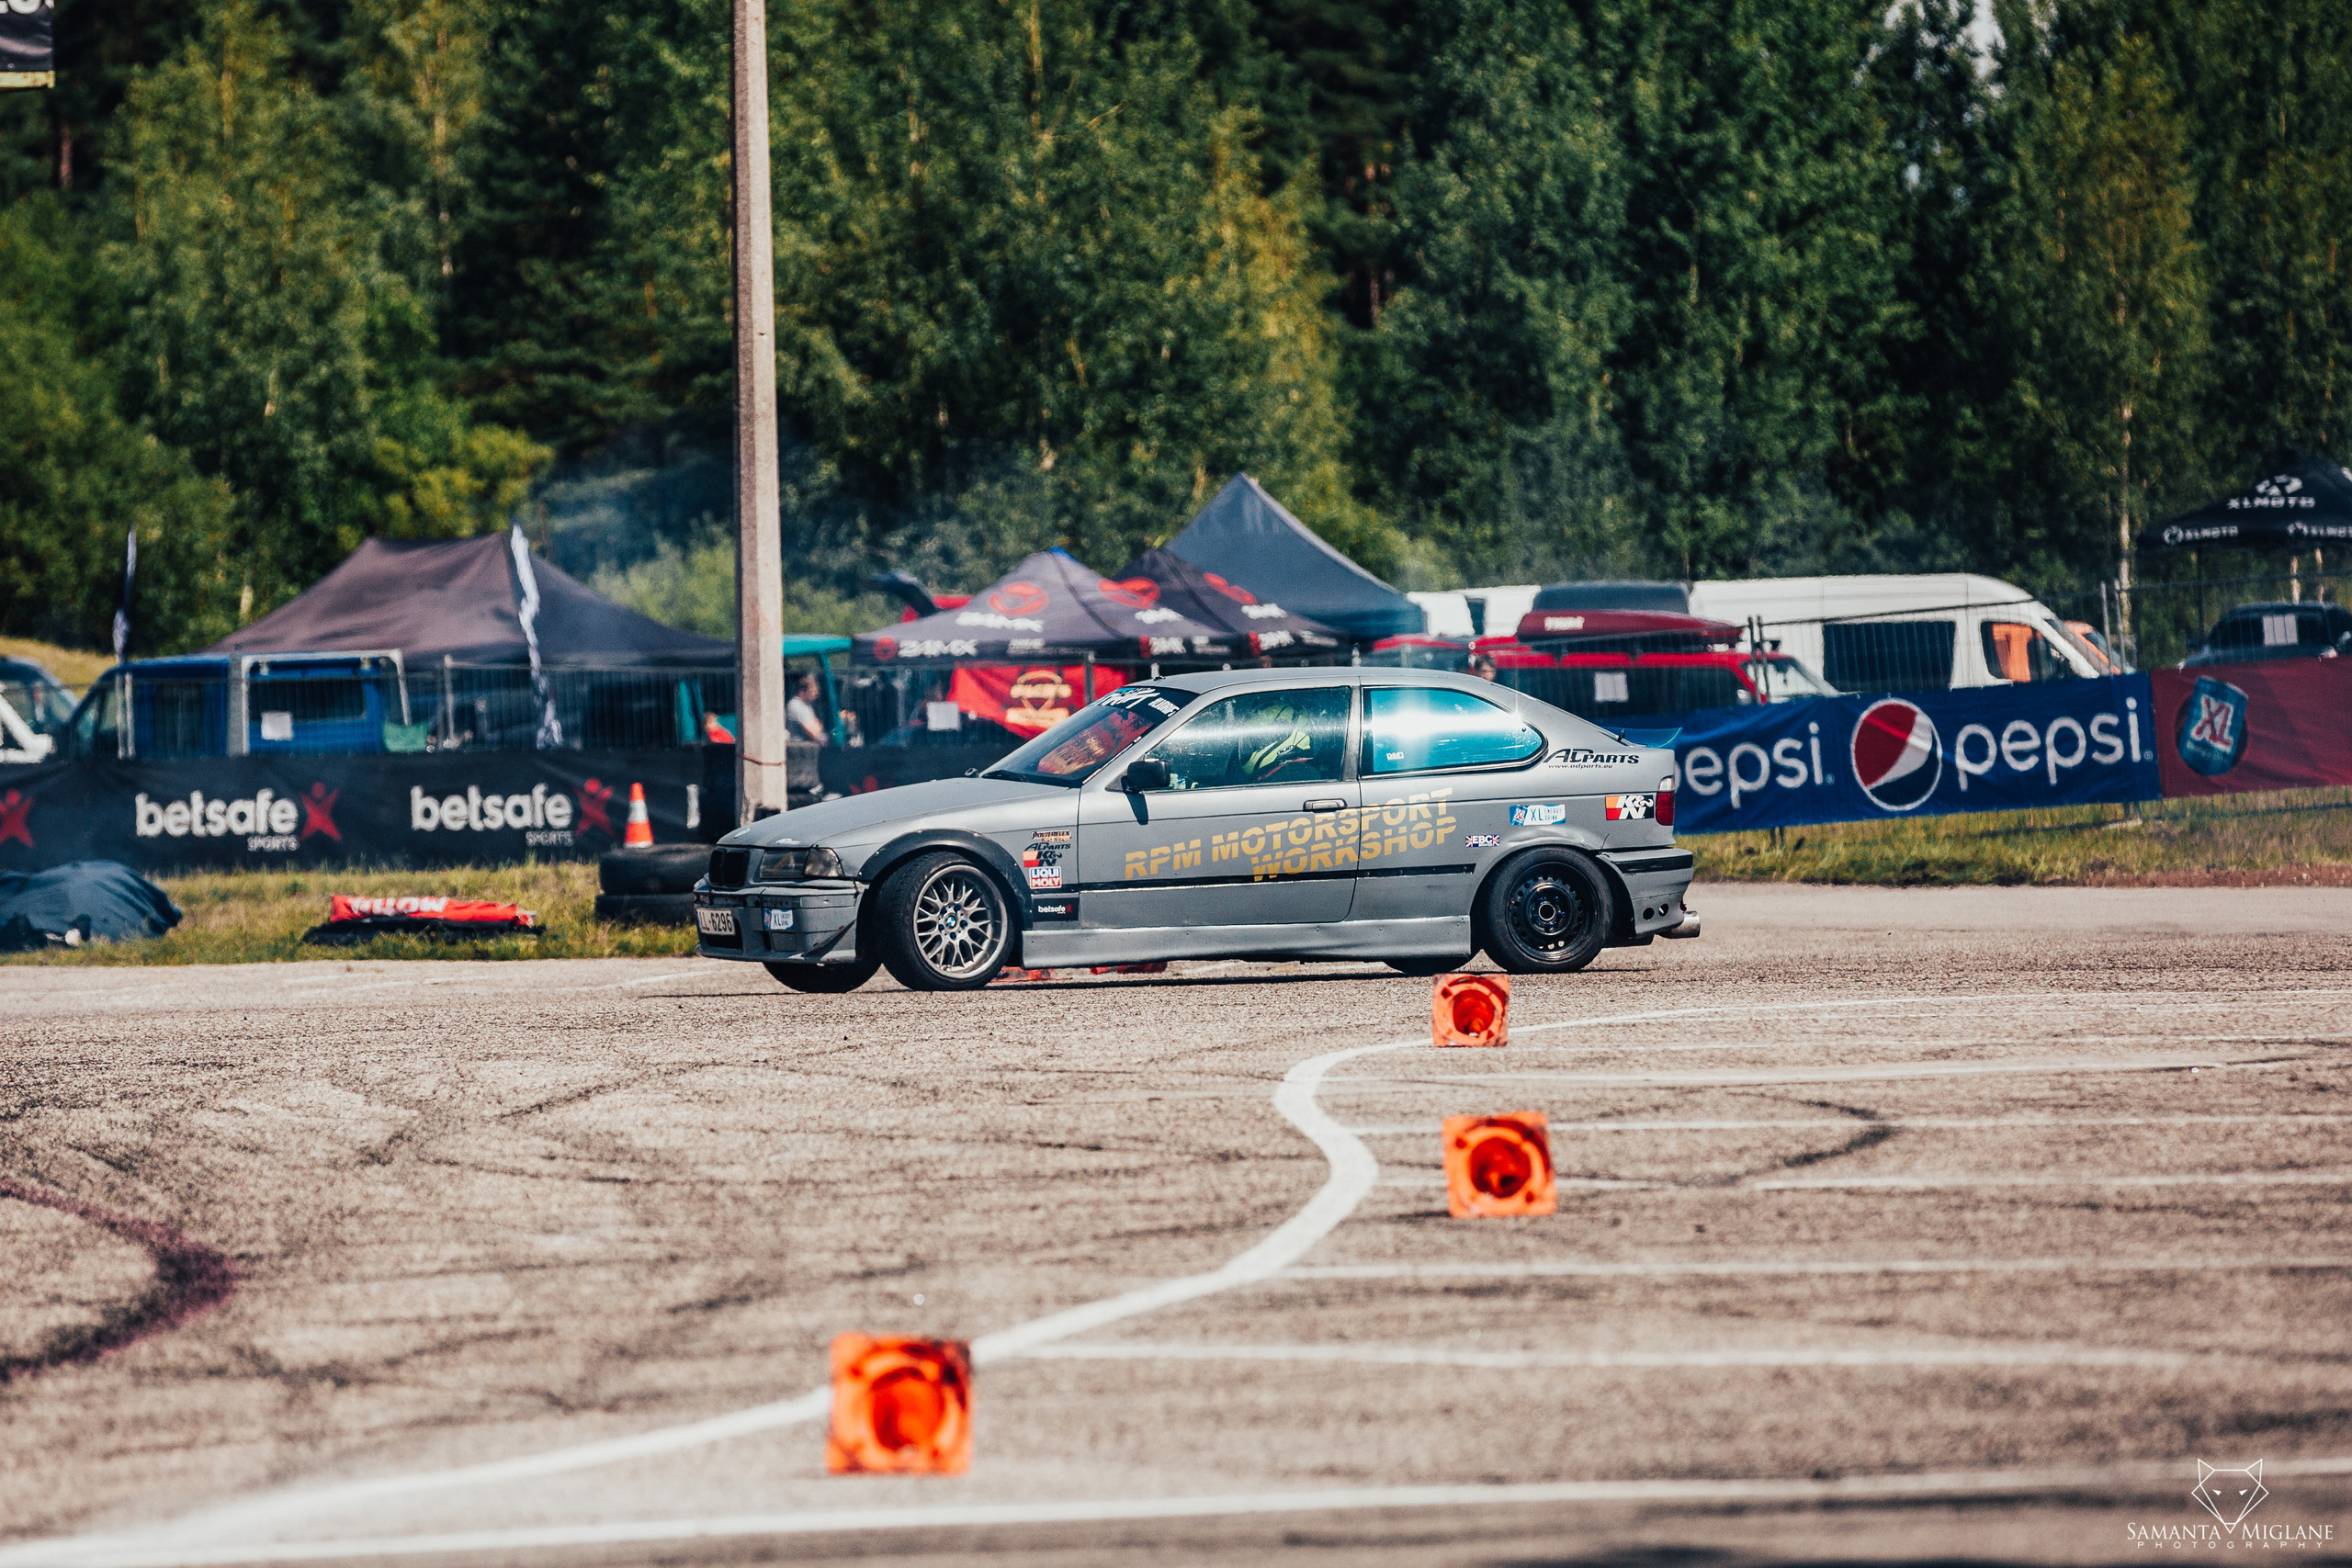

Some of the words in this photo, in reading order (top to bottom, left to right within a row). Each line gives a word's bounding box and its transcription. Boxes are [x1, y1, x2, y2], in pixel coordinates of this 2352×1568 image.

[2191, 695, 2233, 753] XL
[1954, 697, 2142, 792] pepsi
[1674, 721, 1824, 808] epsi
[135, 788, 299, 837] betsafe
[411, 783, 573, 831] betsafe
[1531, 808, 1544, 820] XL
[248, 834, 300, 852] SPORTS
[526, 830, 574, 846] SPORTS
[1125, 839, 1201, 879] RPM
[1212, 787, 1453, 863] MOTORSPORT
[1250, 816, 1456, 882] WORKSHOP
[1472, 835, 1493, 844] EBC
[1031, 868, 1060, 878] LIQUI
[1032, 878, 1060, 887] MOLY
[1038, 905, 1066, 913] betsafe
